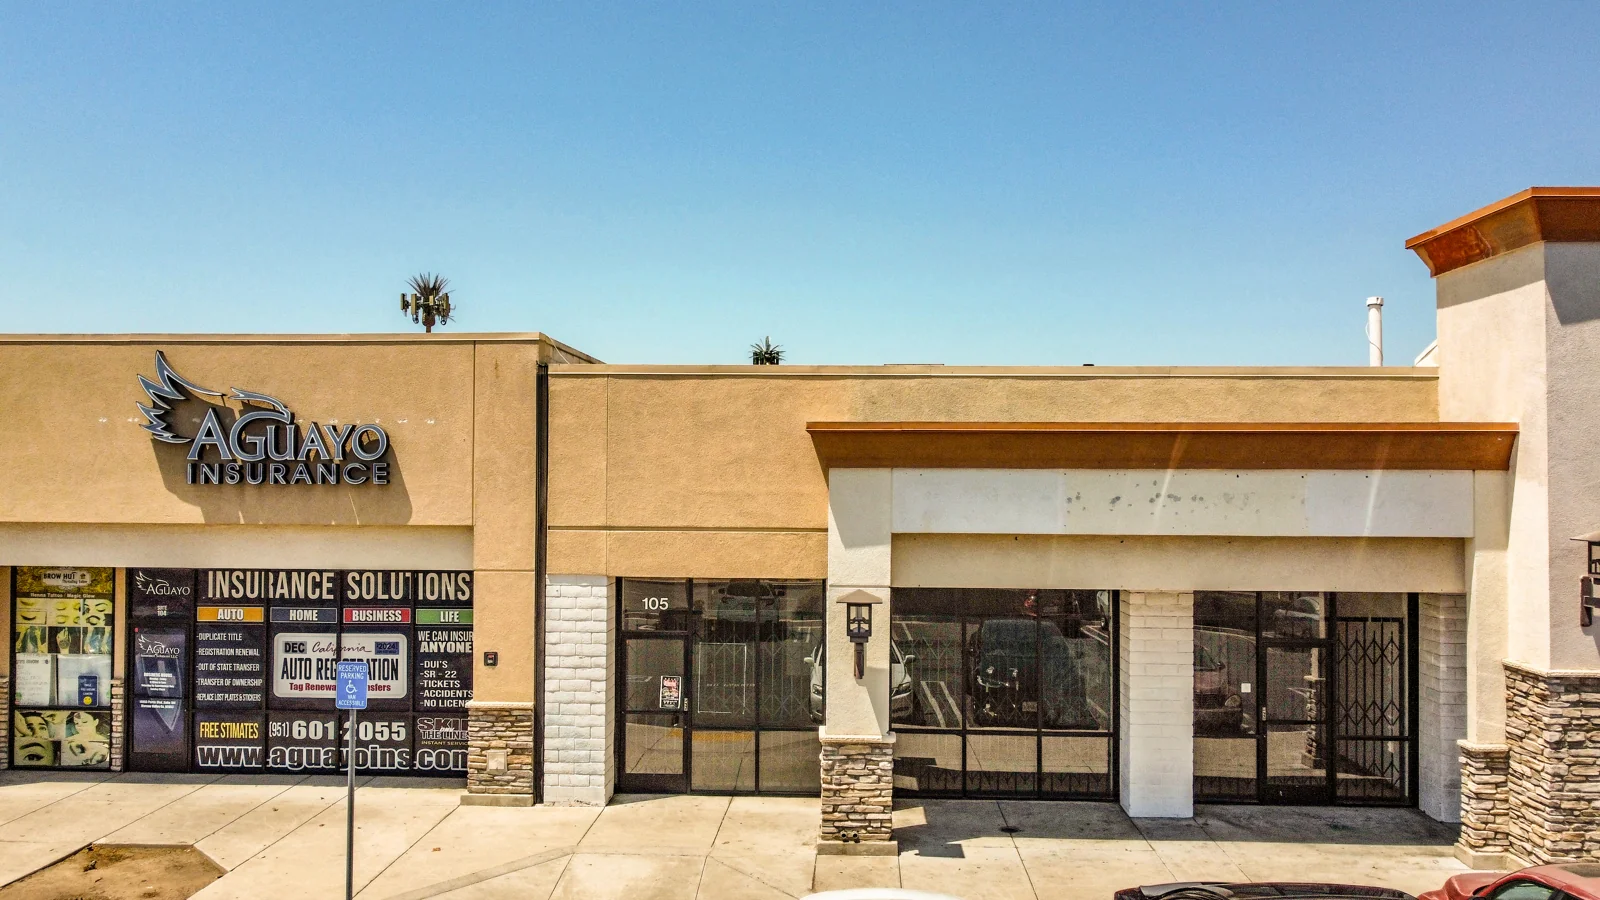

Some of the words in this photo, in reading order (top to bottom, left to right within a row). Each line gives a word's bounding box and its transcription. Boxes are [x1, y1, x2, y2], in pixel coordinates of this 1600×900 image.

[186, 407, 389, 462] AGUAYO
[187, 462, 390, 485] INSURANCE
[63, 572, 77, 580] HUT
[146, 583, 191, 595] AGUAYO
[207, 570, 335, 600] INSURANCE
[347, 571, 471, 601] SOLUTIONS
[642, 597, 669, 610] 105
[217, 608, 244, 620] AUTO
[289, 609, 318, 621] HOME
[352, 610, 402, 622] BUSINESS
[440, 611, 460, 622] LIFE
[228, 633, 243, 641] TITLE
[418, 631, 431, 642] WE
[432, 631, 449, 642] CAN
[450, 631, 474, 642] INSUR
[146, 645, 180, 654] AGUAYO
[284, 642, 305, 653] DEC
[311, 641, 372, 657] Califrnia
[378, 642, 396, 650] 2024
[420, 641, 472, 653] ANYONE
[235, 648, 260, 656] RENEWAL
[209, 663, 216, 671] OF
[216, 663, 232, 671] STATE
[233, 663, 260, 672] TRANSFER
[281, 658, 312, 680] AUTO
[316, 658, 399, 681] REGATION
[338, 664, 367, 673] RESERVED
[340, 672, 365, 680] PARKING
[444, 670, 457, 678] 22
[225, 678, 231, 686] OF
[231, 678, 263, 687] OWNERSHIP
[289, 683, 304, 691] Tag
[305, 683, 337, 691] Renewa
[439, 699, 465, 708] LICEN
[200, 722, 220, 738] FREE
[220, 723, 259, 739] STIMATES
[269, 721, 290, 737] (951)
[421, 730, 441, 740] THE
